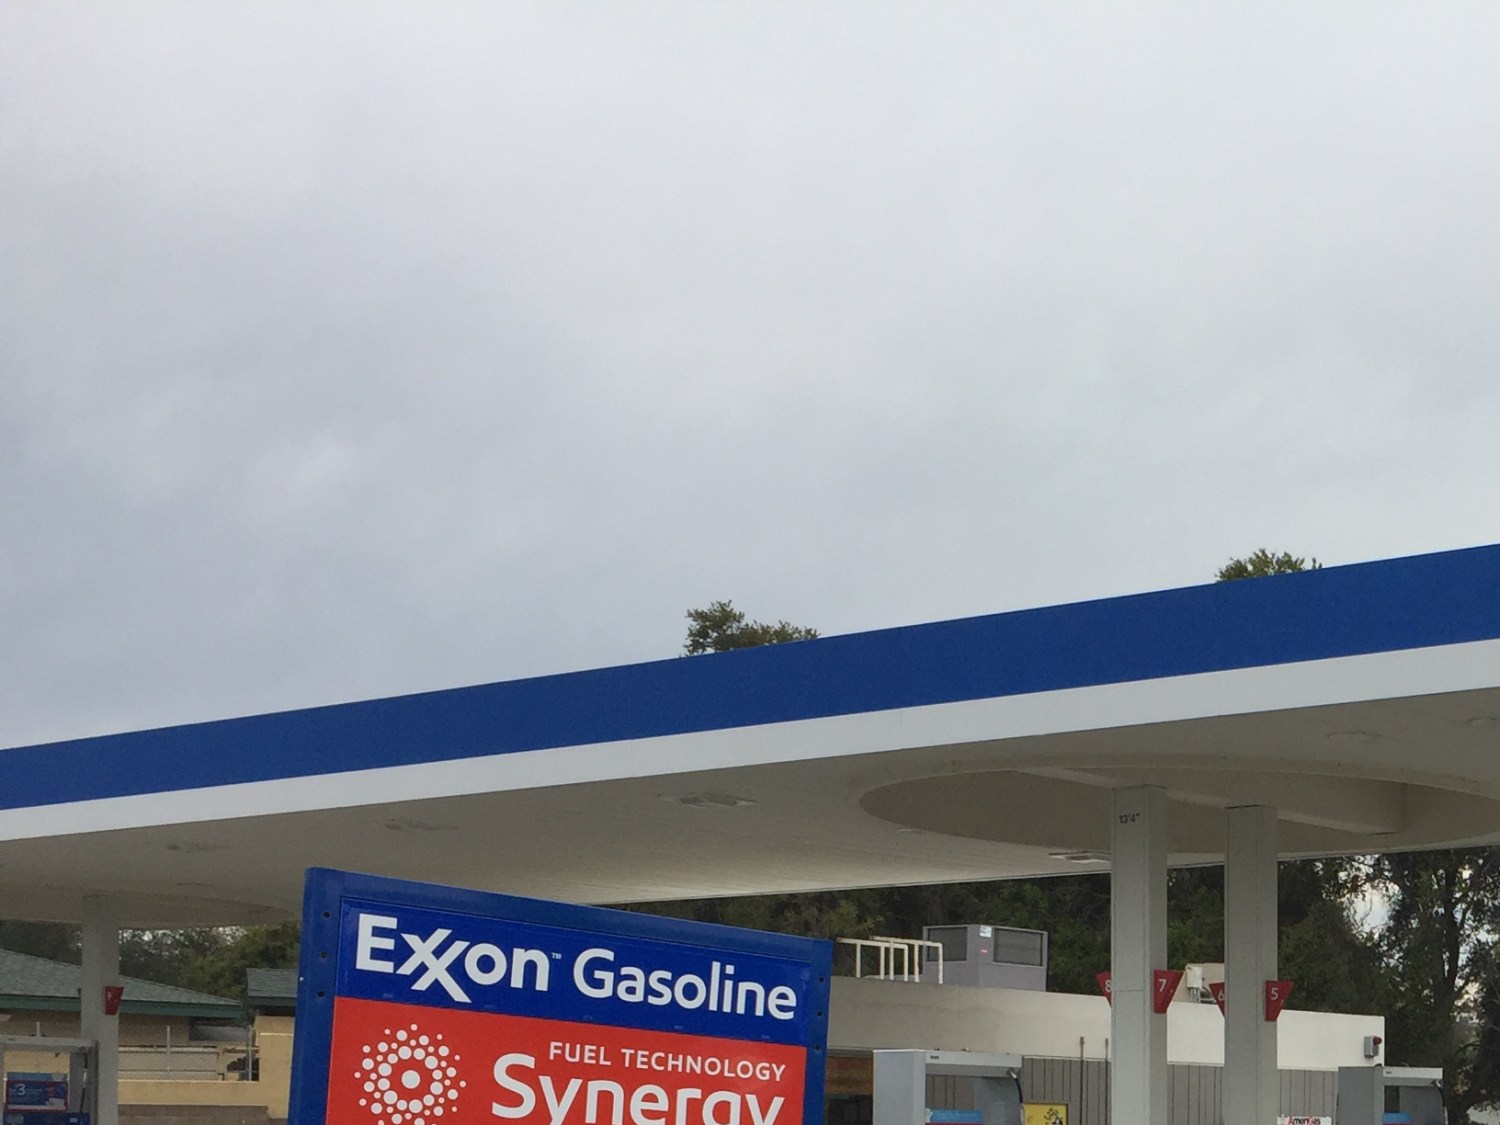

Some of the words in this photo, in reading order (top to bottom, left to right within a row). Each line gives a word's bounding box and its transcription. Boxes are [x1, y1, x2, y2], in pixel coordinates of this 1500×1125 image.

[356, 914, 549, 1002] Exxon
[574, 949, 797, 1020] Gasoline
[1158, 979, 1167, 992] 7
[1271, 988, 1279, 999] 5
[549, 1042, 611, 1066] FUEL
[621, 1049, 786, 1081] TECHNOLOGY
